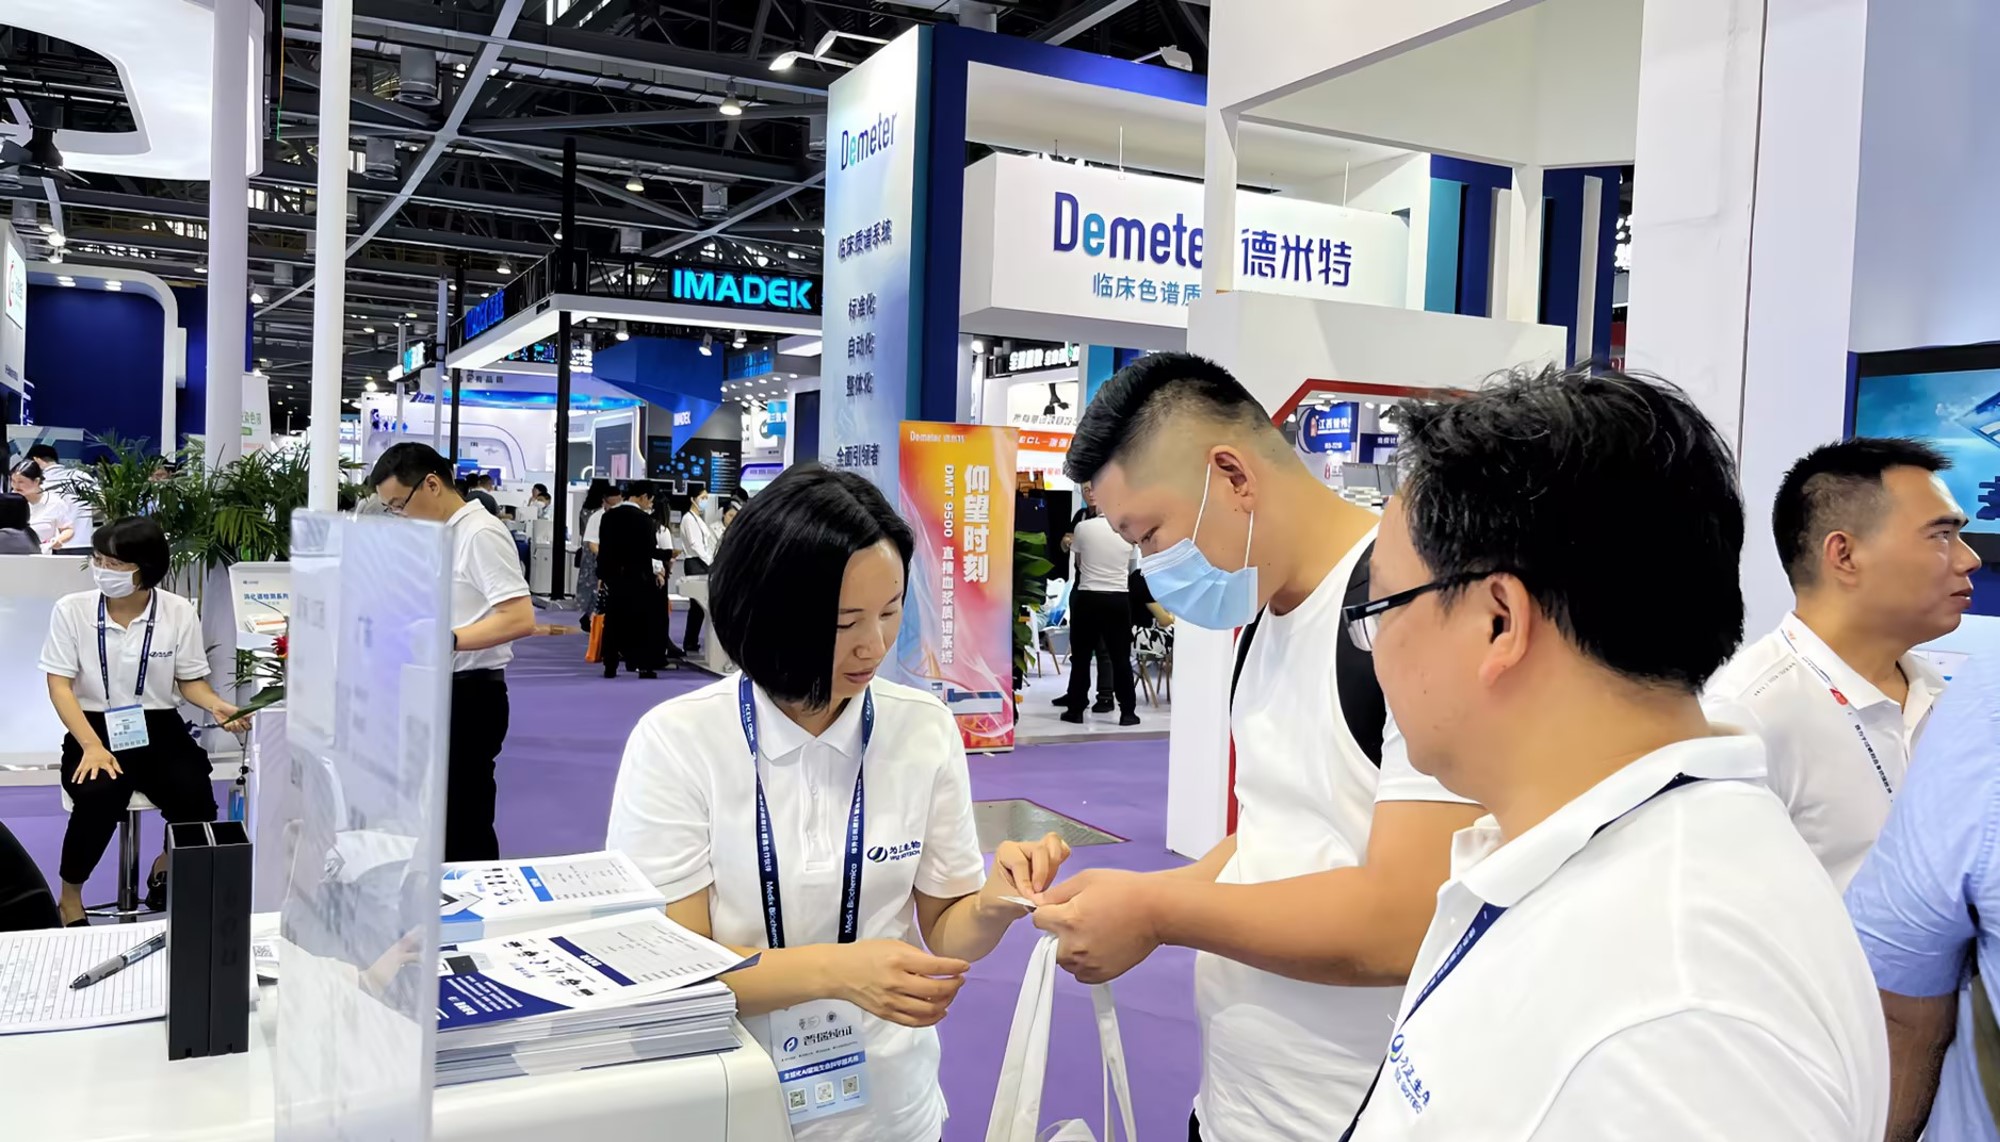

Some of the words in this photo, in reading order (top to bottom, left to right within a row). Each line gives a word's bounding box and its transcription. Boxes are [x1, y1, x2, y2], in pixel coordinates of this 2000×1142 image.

[841, 112, 897, 171] Demeter
[838, 218, 892, 262] 临床质谱系统
[1241, 228, 1352, 287] 德米特
[673, 269, 813, 309] IMADEK
[848, 293, 876, 320] 标准化
[847, 332, 875, 358] 自动化
[846, 372, 873, 397] 整体化
[836, 442, 880, 468] 全面引领者
[944, 464, 955, 497] DMT
[943, 501, 954, 538] 9500
[963, 464, 990, 584] 仰望时刻
[766, 881, 775, 906] Medix
[845, 908, 853, 933] Medix
